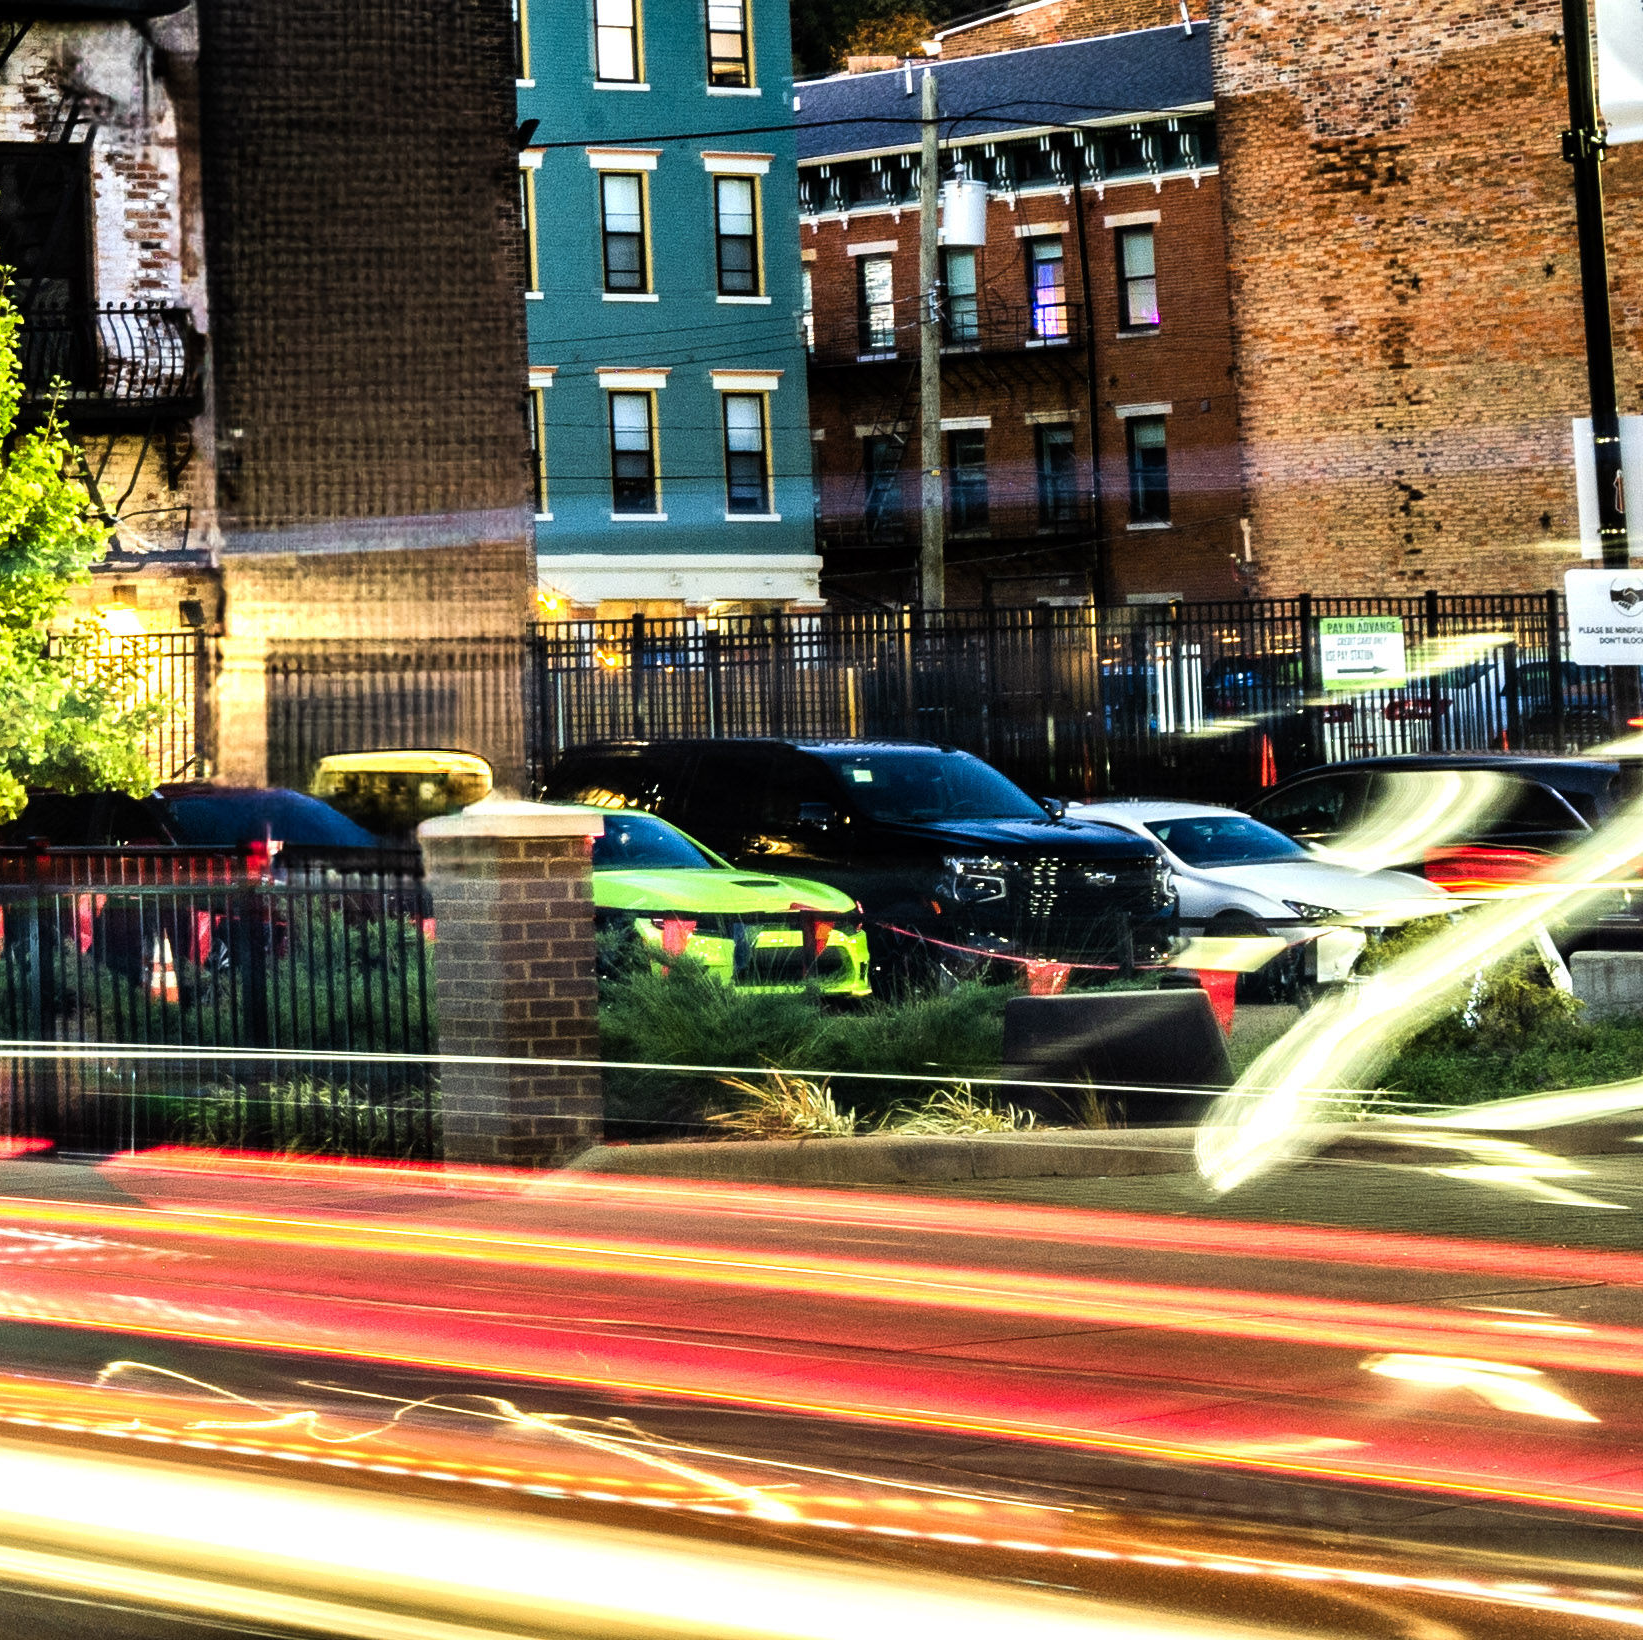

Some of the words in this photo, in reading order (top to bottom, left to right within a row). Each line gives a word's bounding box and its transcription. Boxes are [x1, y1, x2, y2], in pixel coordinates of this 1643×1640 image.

[1327, 623, 1343, 634] PAY
[1346, 622, 1355, 633] IN
[1357, 621, 1396, 633] ADVANCE
[1578, 626, 1603, 634] PLEASE
[1605, 626, 1613, 634] BE
